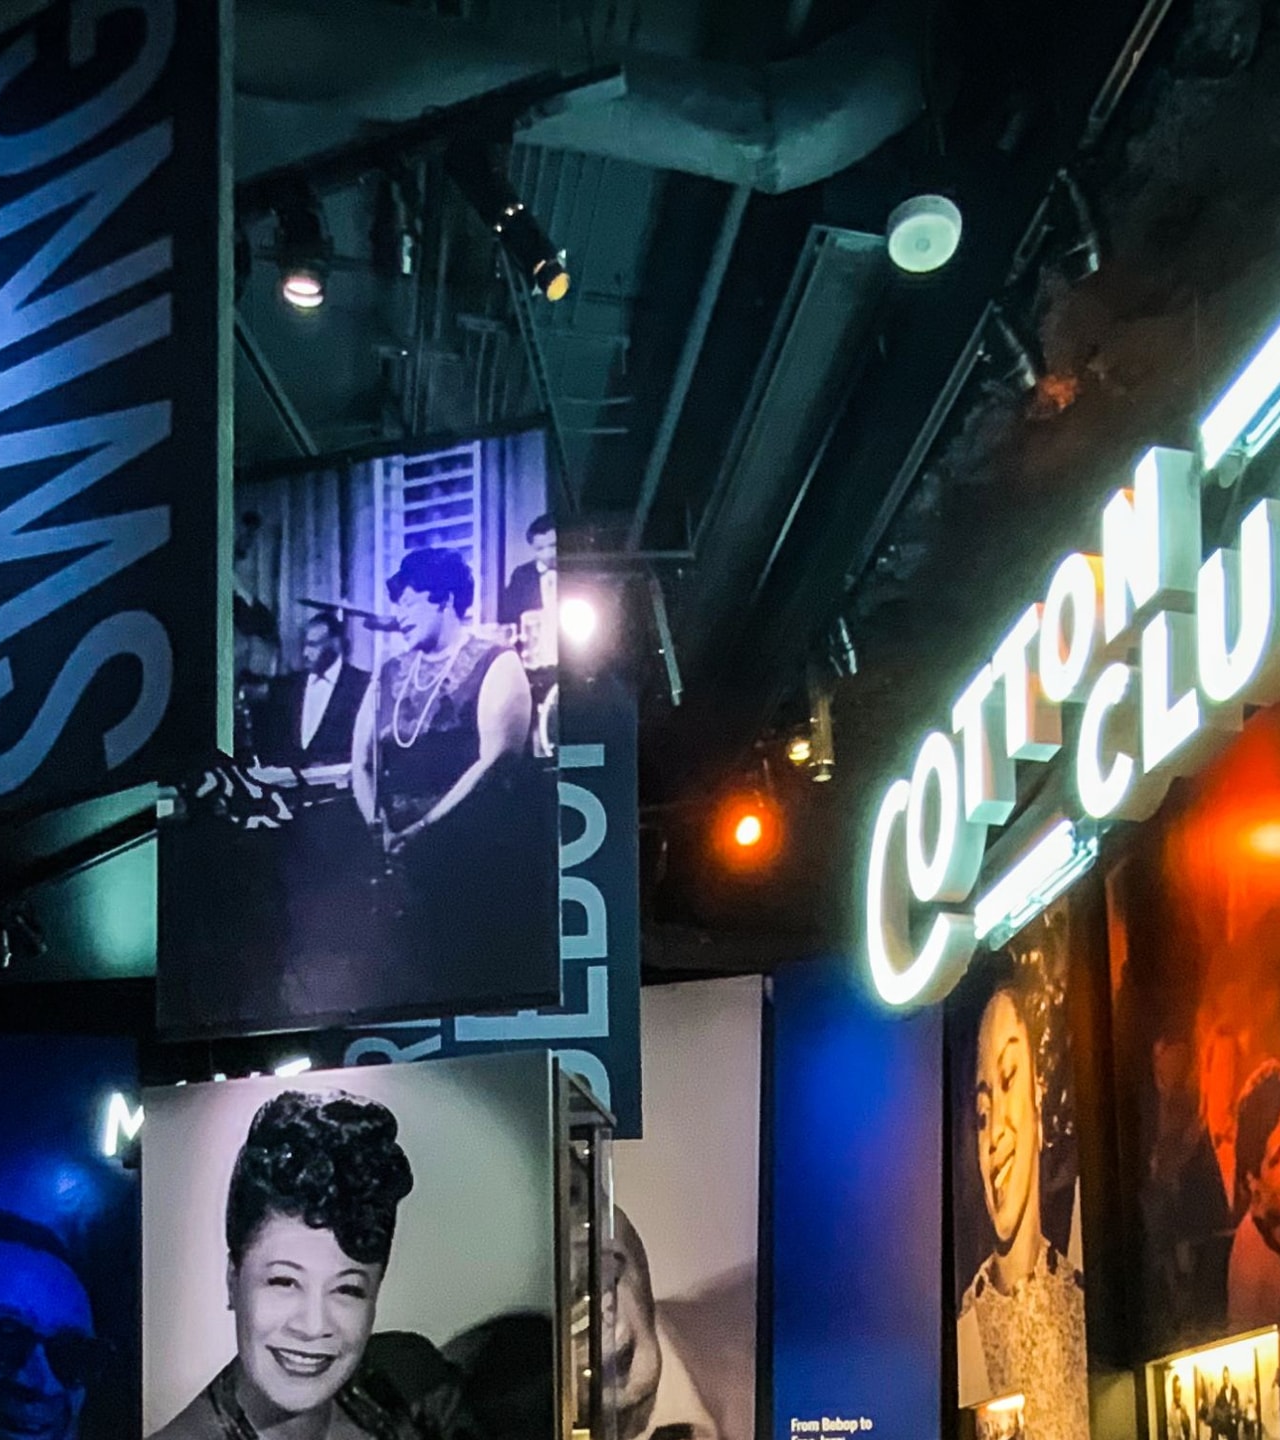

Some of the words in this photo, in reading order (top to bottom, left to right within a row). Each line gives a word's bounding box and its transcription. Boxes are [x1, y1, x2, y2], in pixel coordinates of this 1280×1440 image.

[867, 446, 1190, 1004] COTTON
[791, 1417, 820, 1432] From
[821, 1416, 859, 1434] Bebop
[860, 1416, 874, 1430] to
